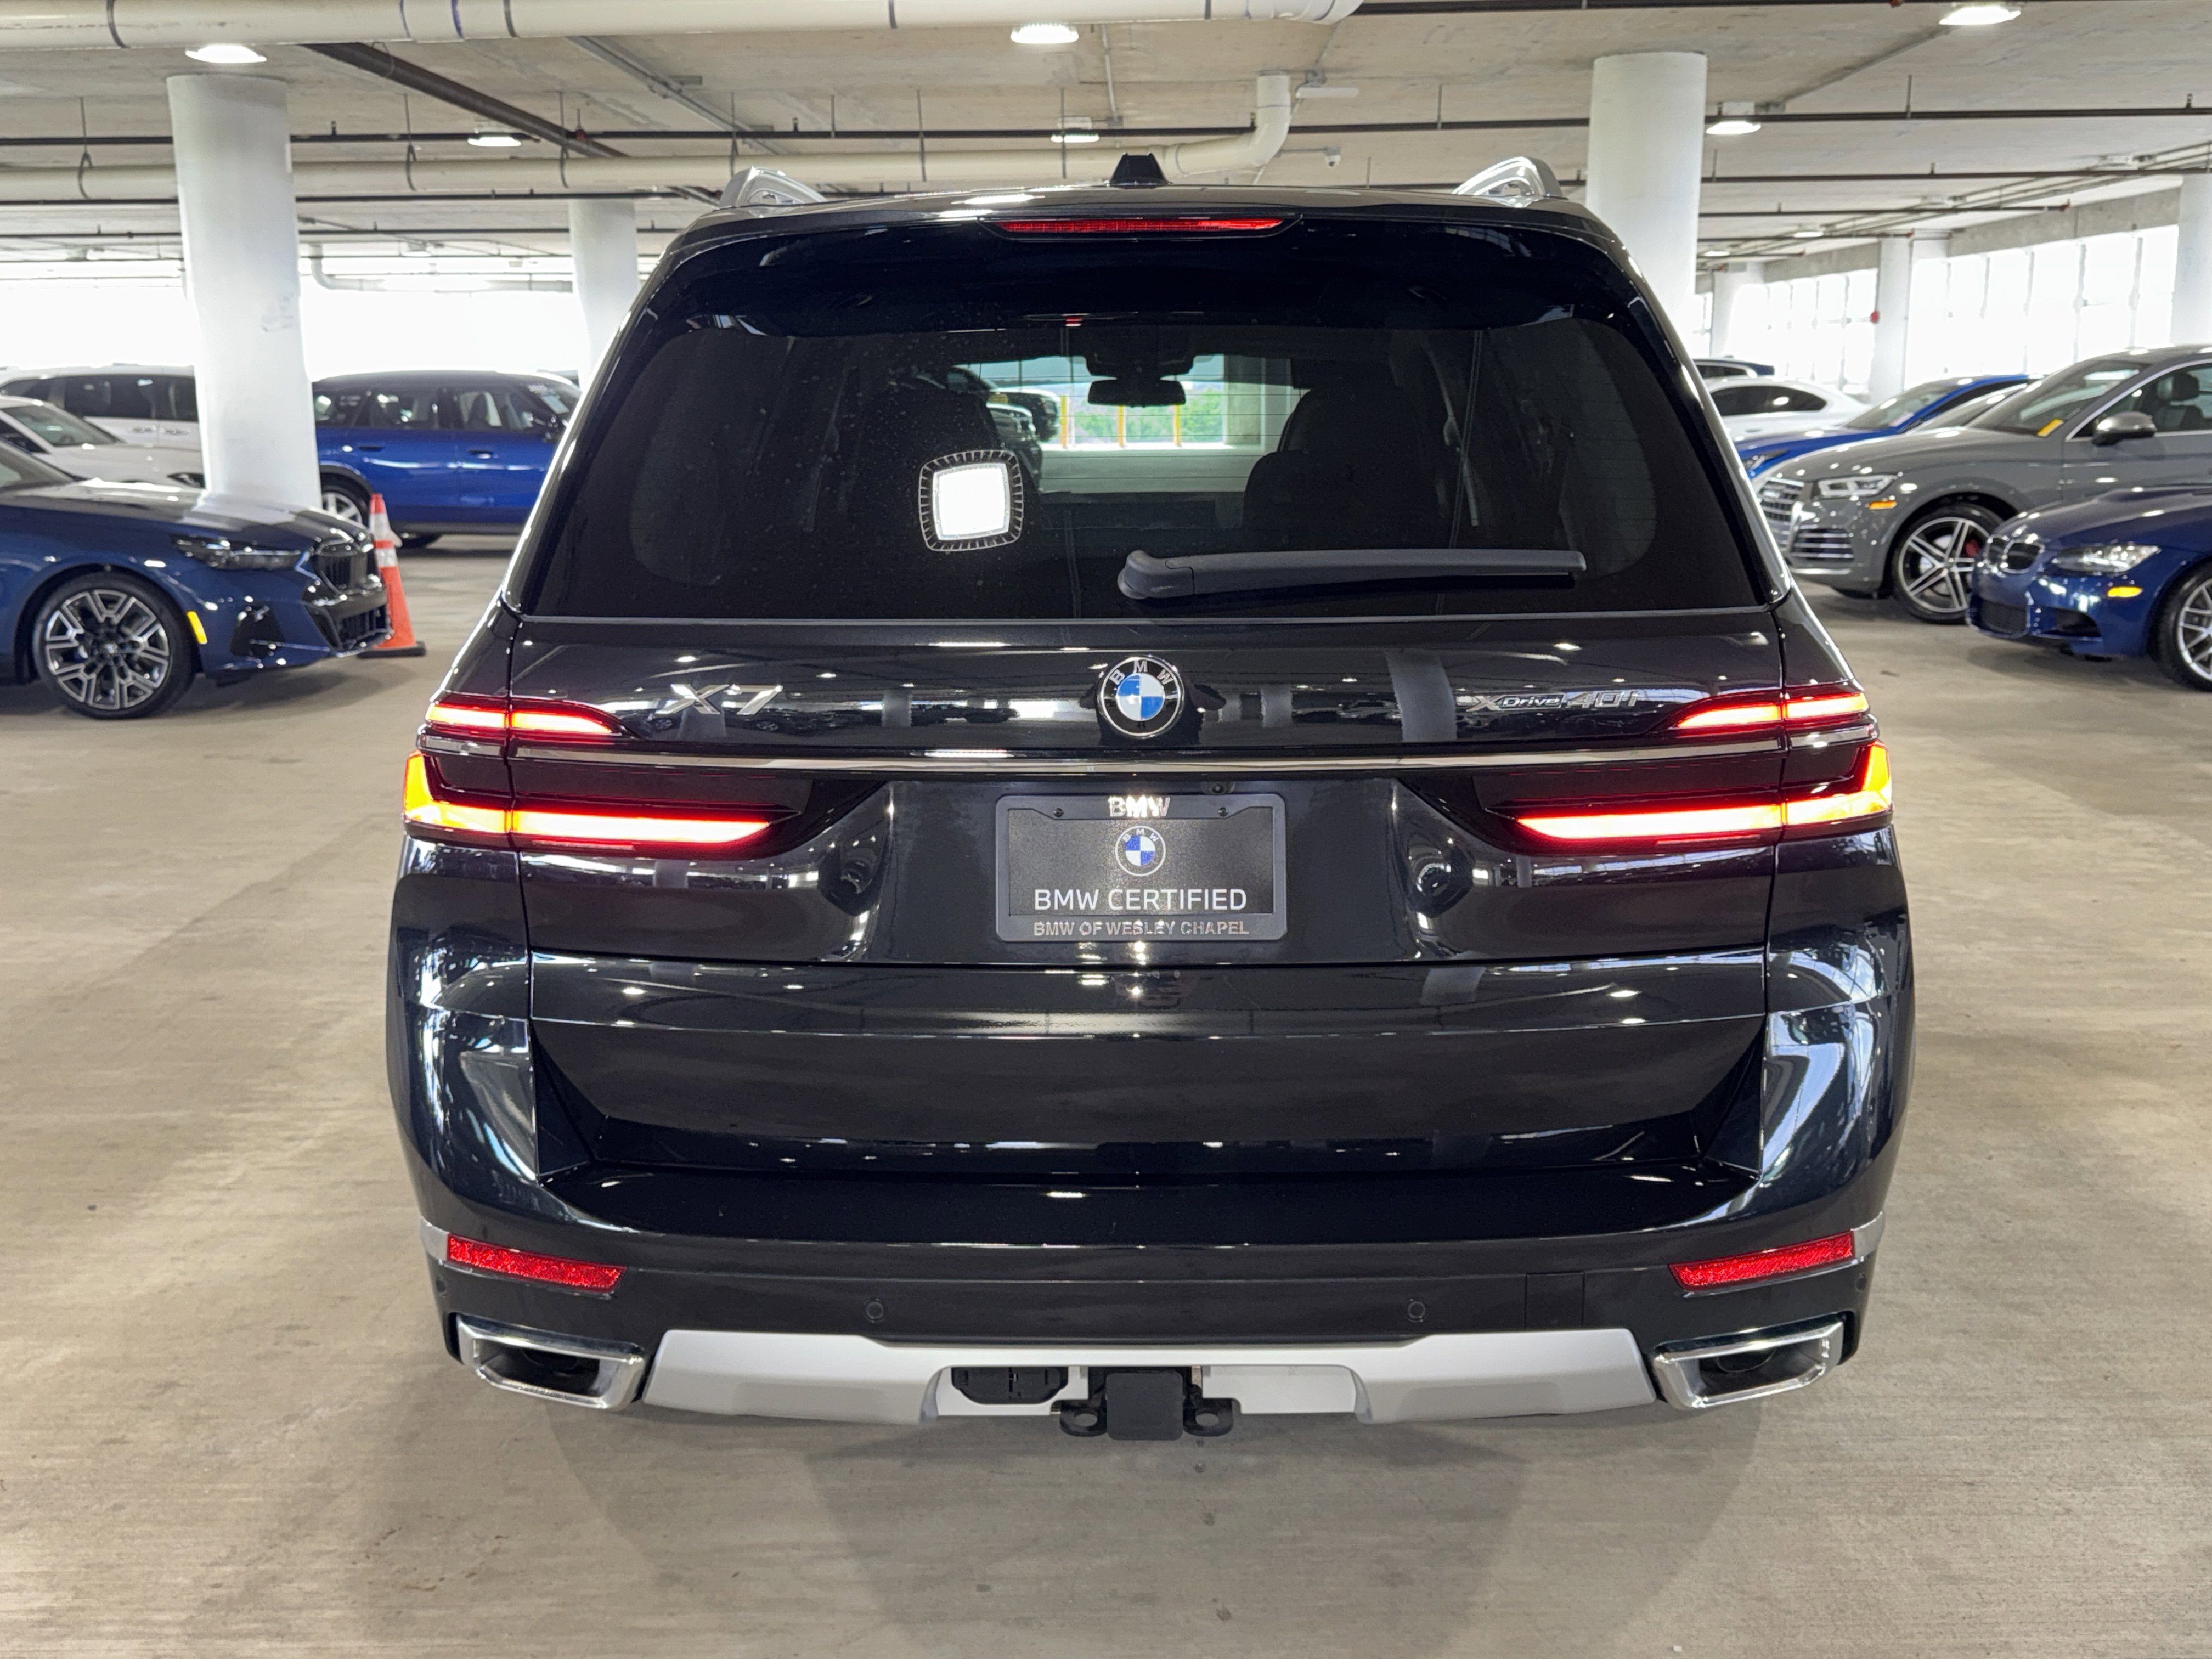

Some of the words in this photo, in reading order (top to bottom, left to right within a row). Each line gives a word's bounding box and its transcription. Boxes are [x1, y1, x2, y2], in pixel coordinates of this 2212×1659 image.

[1109, 660, 1173, 685] BMW
[655, 684, 783, 715] X7
[1567, 690, 1638, 709] 40i
[1108, 796, 1171, 818] BMW
[1122, 829, 1159, 842] BMW
[1035, 889, 1099, 910] BMW
[1108, 889, 1246, 910] CERTIFIED
[1034, 921, 1075, 936] BMW
[1079, 921, 1103, 936] OF
[1105, 920, 1176, 935] WESLEY
[1180, 921, 1249, 935] CHAPEL
